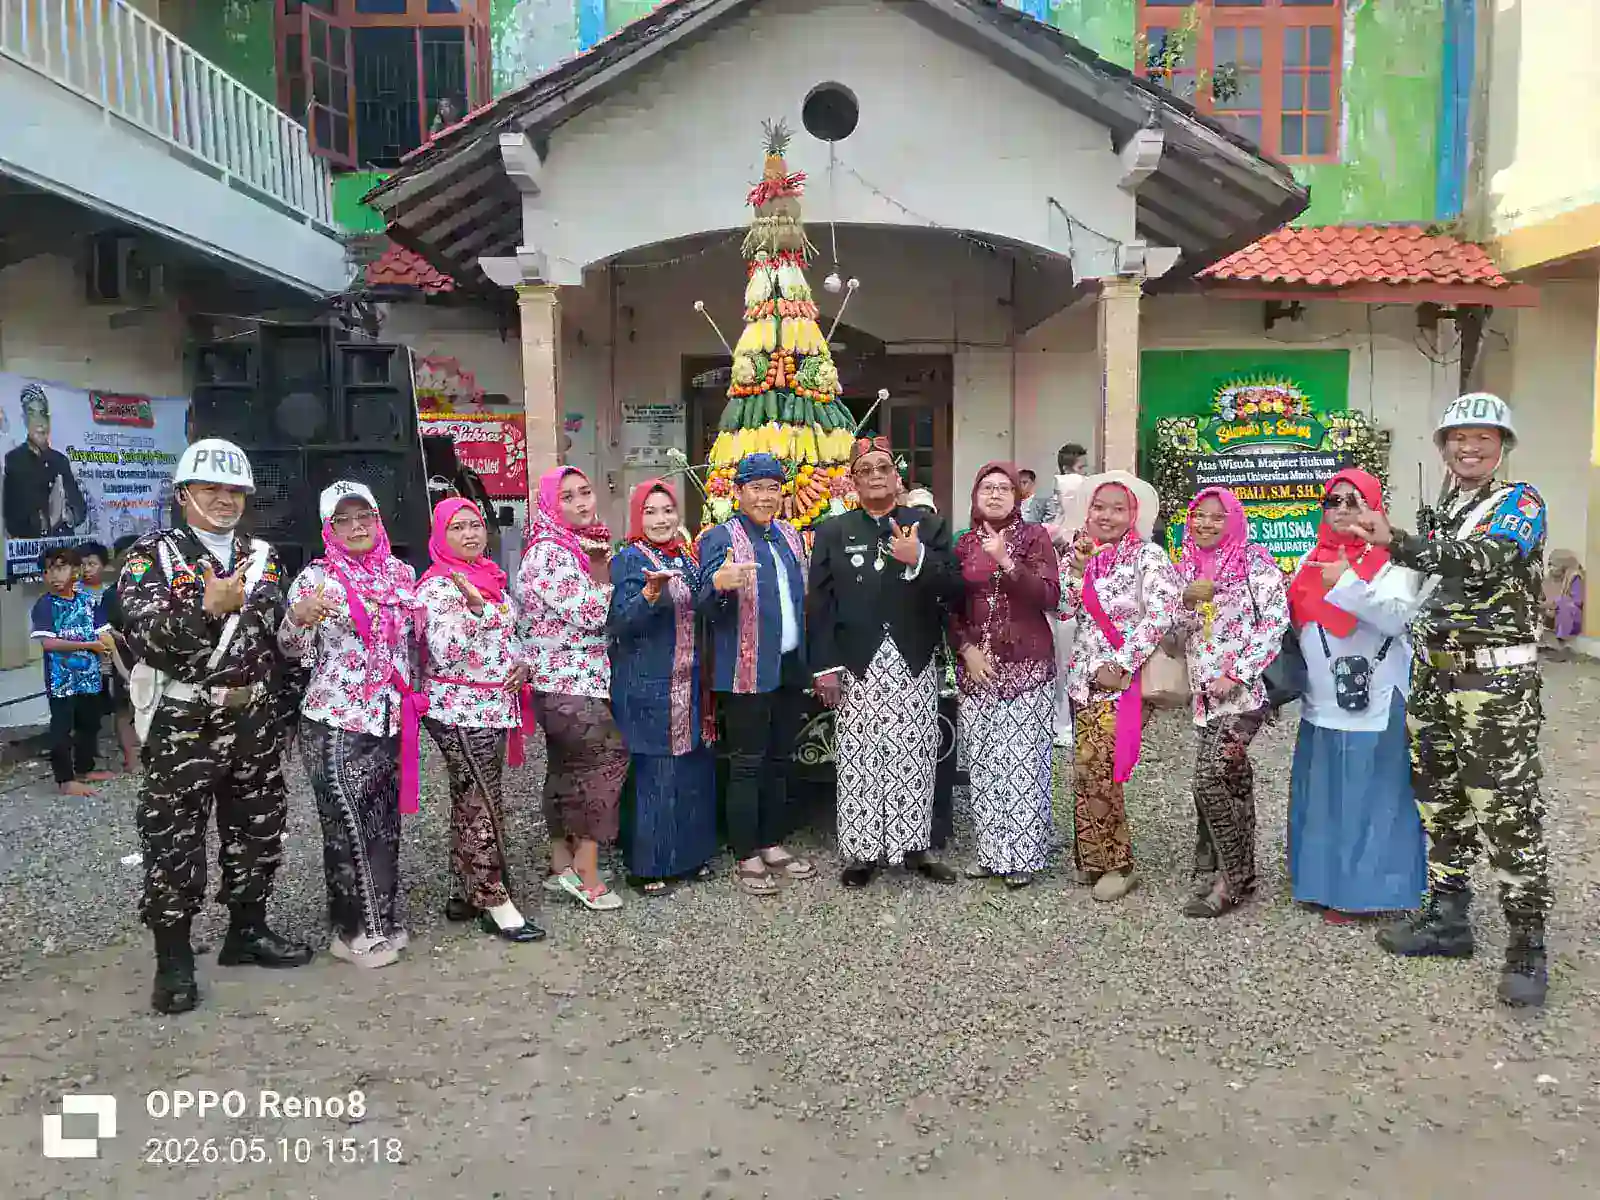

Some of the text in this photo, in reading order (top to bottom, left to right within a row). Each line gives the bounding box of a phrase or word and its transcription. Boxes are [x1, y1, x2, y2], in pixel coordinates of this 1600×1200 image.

[1219, 458, 1255, 470] Wisuda
[1258, 457, 1299, 471] Magister
[1300, 456, 1336, 468] Hukum
[1247, 472, 1288, 483] Universitas
